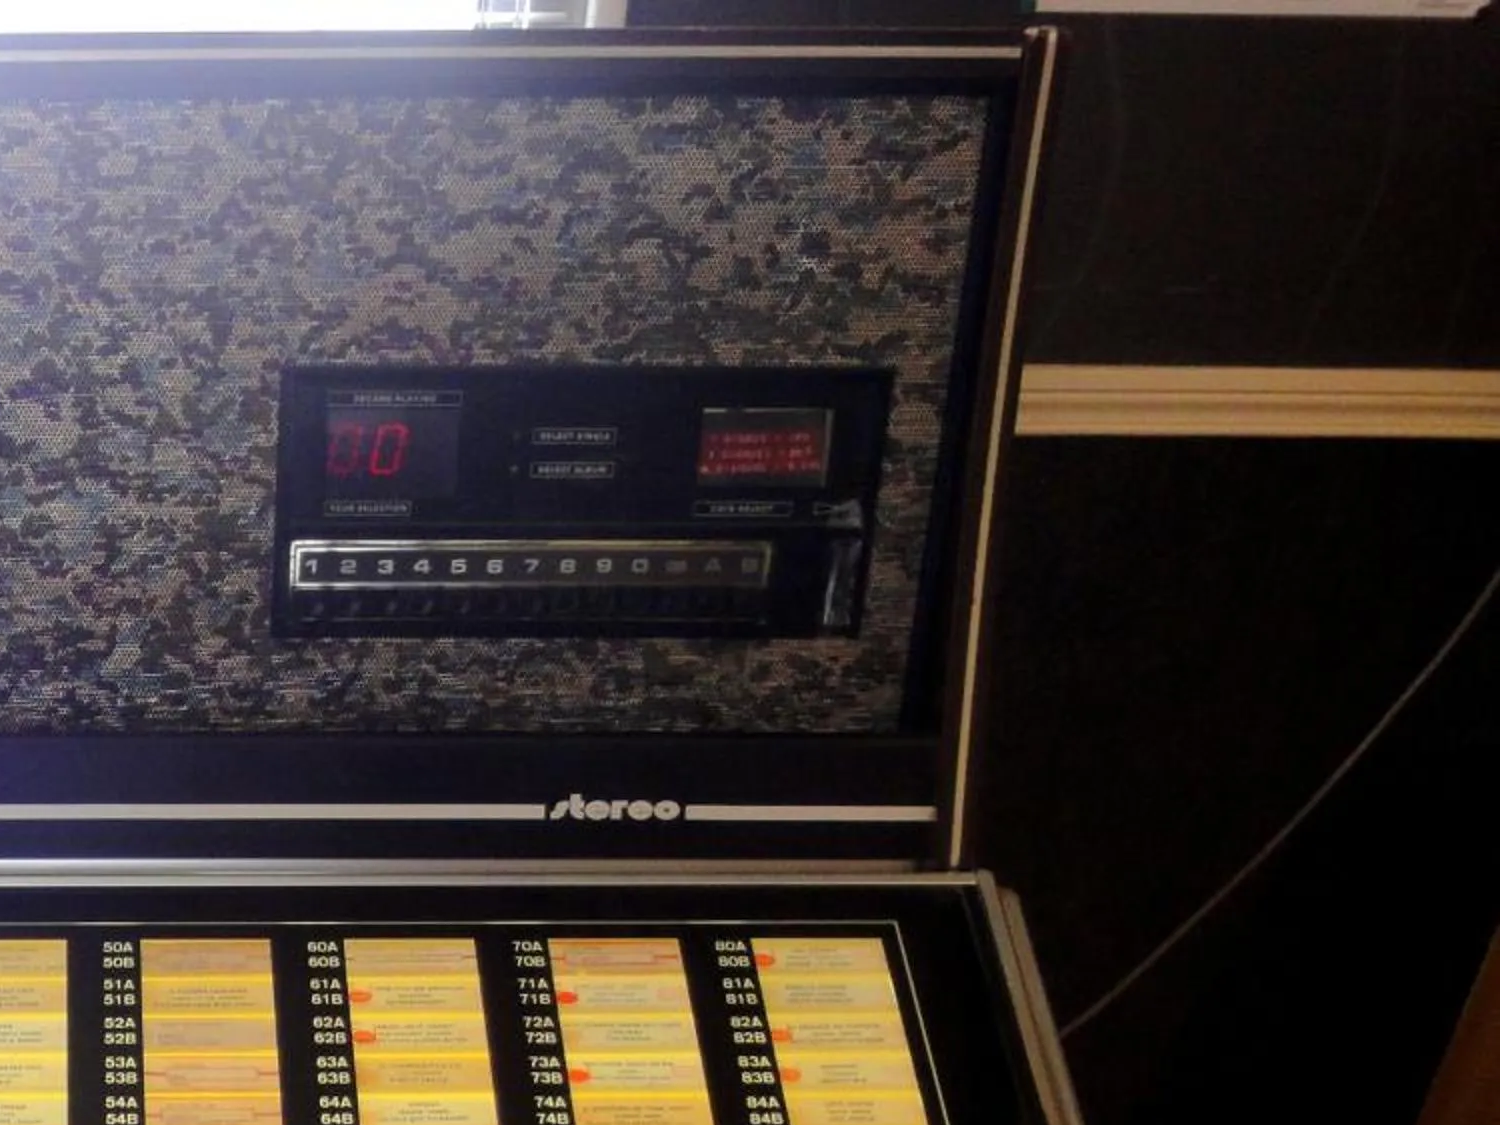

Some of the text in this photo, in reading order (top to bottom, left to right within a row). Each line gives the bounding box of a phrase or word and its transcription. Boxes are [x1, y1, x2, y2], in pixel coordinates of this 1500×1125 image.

[305, 559, 318, 574] 1
[340, 559, 357, 574] 2
[377, 559, 394, 574] 3
[413, 559, 431, 574] 4
[451, 559, 467, 574] 5
[486, 559, 503, 574] 6
[524, 559, 542, 574] 7
[559, 559, 576, 574] 8
[596, 559, 612, 574] 9
[549, 792, 682, 821] stereo
[103, 942, 133, 952] 50A
[308, 942, 338, 952] 60A
[104, 979, 134, 990] 51A
[310, 979, 341, 989] 61A
[518, 978, 548, 989] 71A
[104, 994, 135, 1005] 51B
[311, 994, 343, 1004] 61B
[520, 994, 551, 1004] 71B
[104, 1017, 136, 1028] 52A
[313, 1016, 344, 1028] 62A
[524, 1016, 554, 1028] 72A
[104, 1032, 136, 1044] 52B
[314, 1032, 347, 1044] 62B
[526, 1032, 557, 1043] 72B
[105, 1056, 136, 1068] 53A
[317, 1056, 348, 1068] 63A
[530, 1056, 560, 1068] 73A
[105, 1072, 138, 1084] 53B
[318, 1072, 350, 1084] 63B
[531, 1072, 563, 1084] 73B
[105, 1096, 137, 1108] 54A
[320, 1096, 352, 1108] 64A
[535, 1096, 566, 1108] 74A
[746, 1096, 780, 1108] 84A
[106, 1113, 138, 1125] 54B
[321, 1113, 354, 1124] 64B
[536, 1113, 569, 1124] 74B
[750, 1112, 784, 1125] 84B
